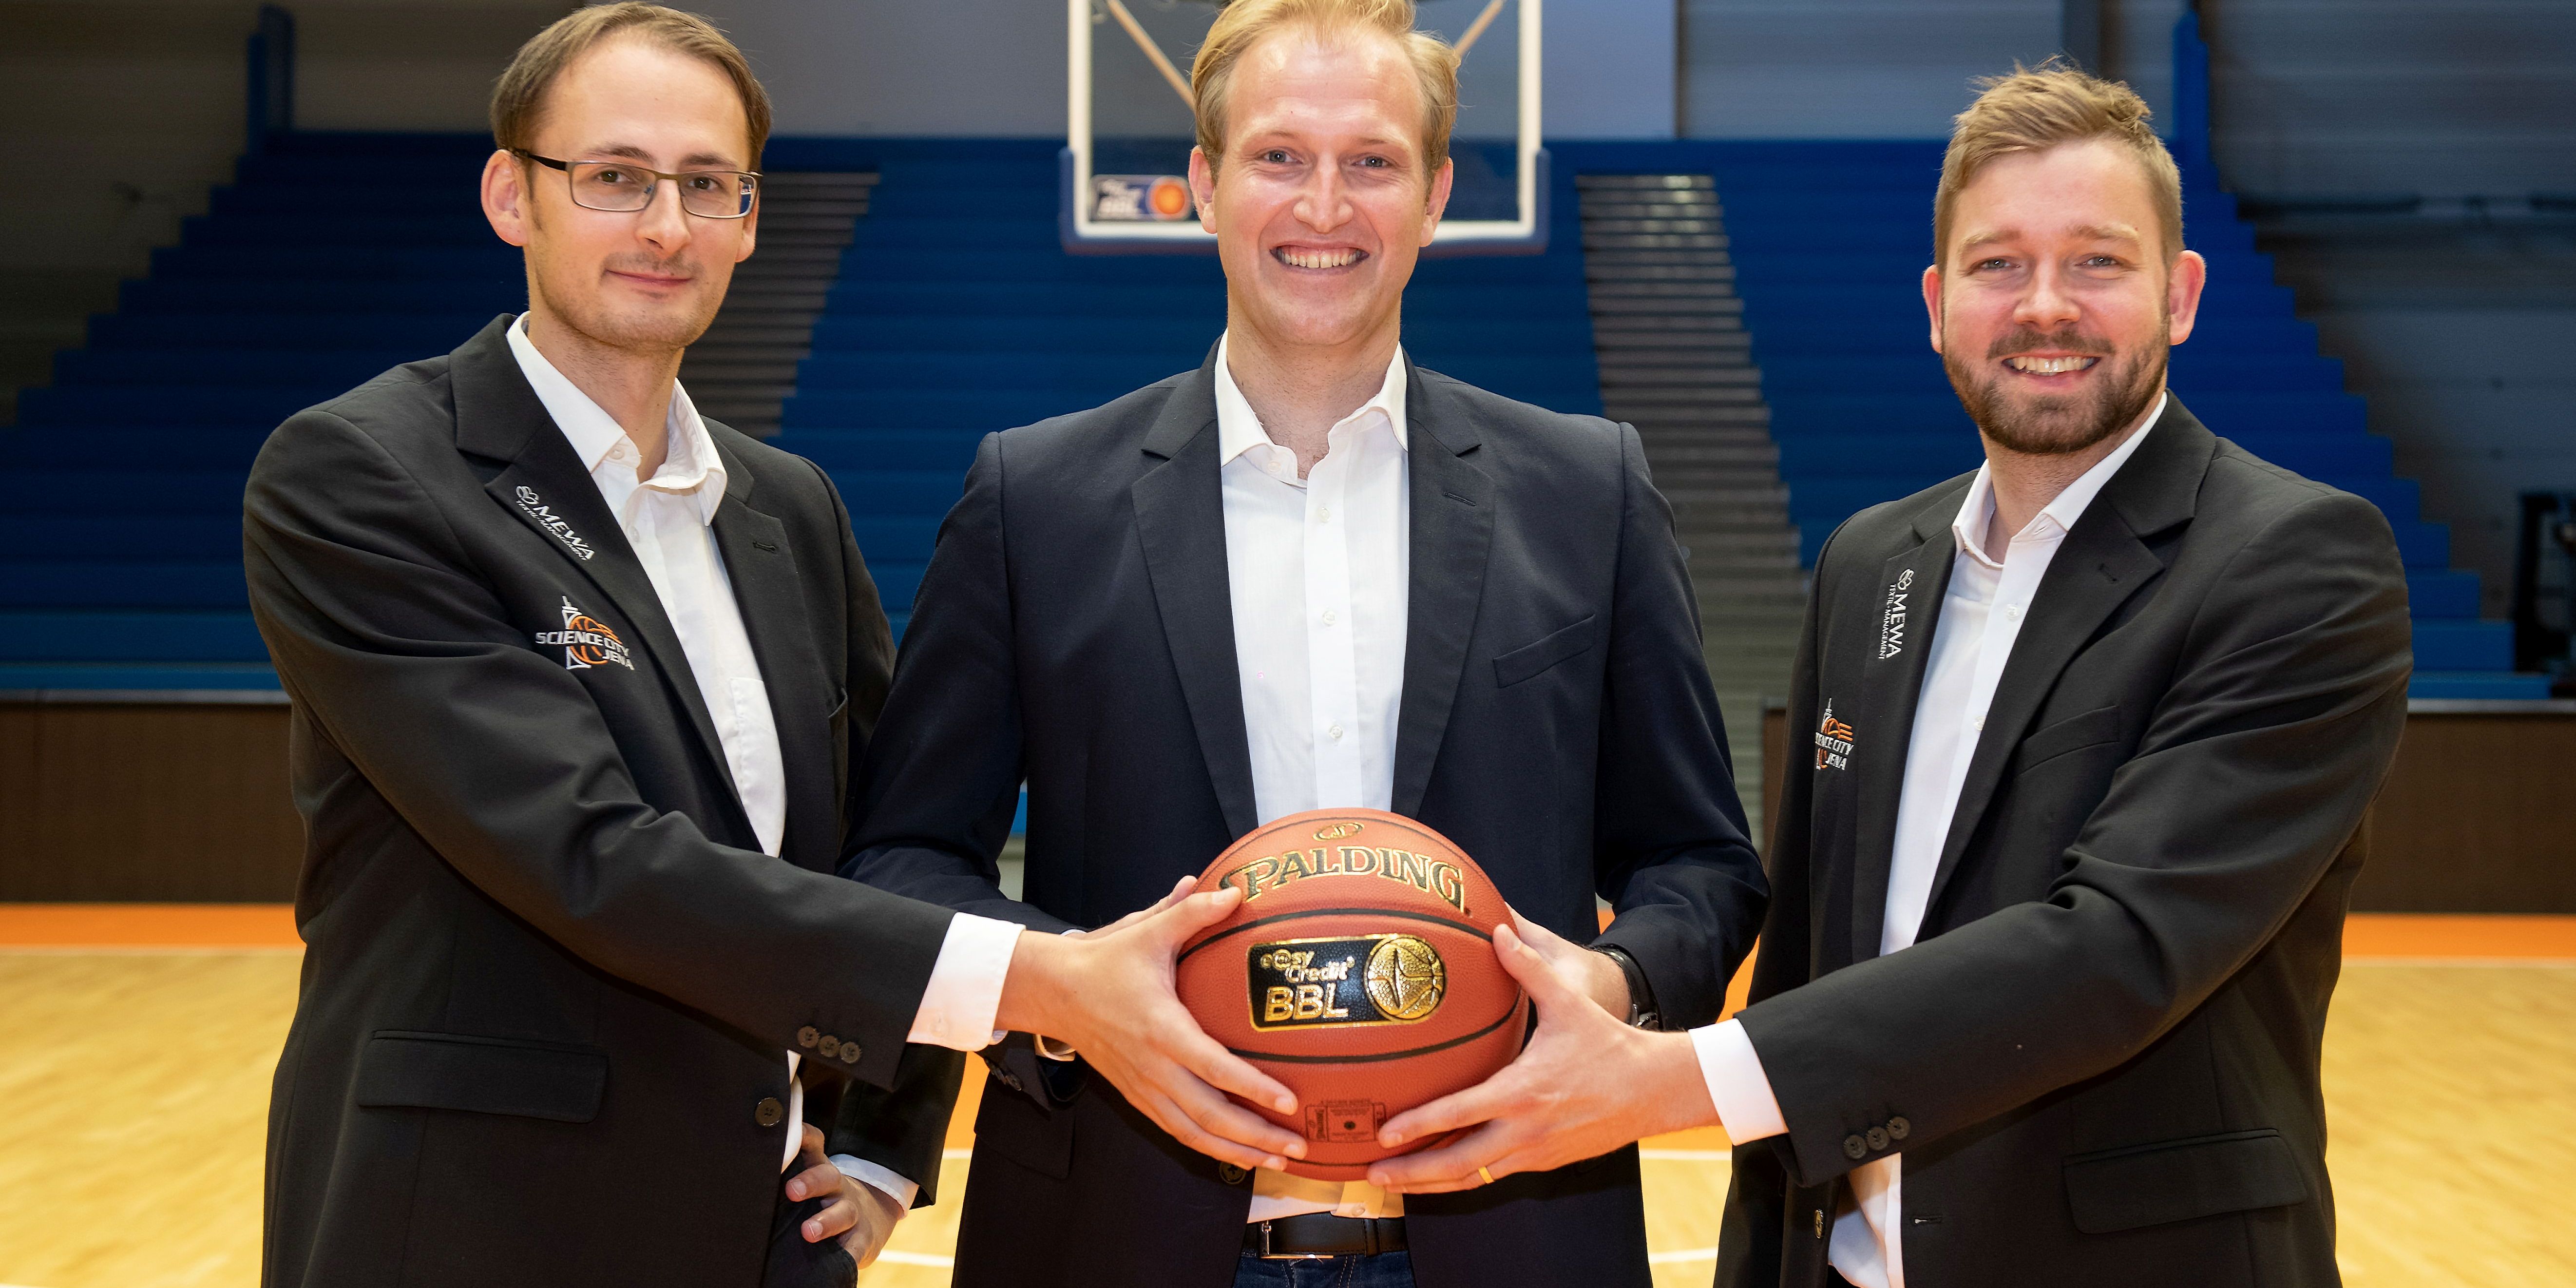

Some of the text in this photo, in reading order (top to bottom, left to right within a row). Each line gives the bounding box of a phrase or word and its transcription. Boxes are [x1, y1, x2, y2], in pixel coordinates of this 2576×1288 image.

[533, 505, 595, 559] MEWA
[1886, 593, 1908, 658] MEWA
[535, 631, 630, 657] SCIENCE CITY
[602, 649, 635, 671] JENA
[1825, 752, 1847, 770] JENA
[1832, 739, 1854, 755] CITY
[1219, 846, 1464, 913] SPALDING
[1264, 982, 1349, 1022] BBL
